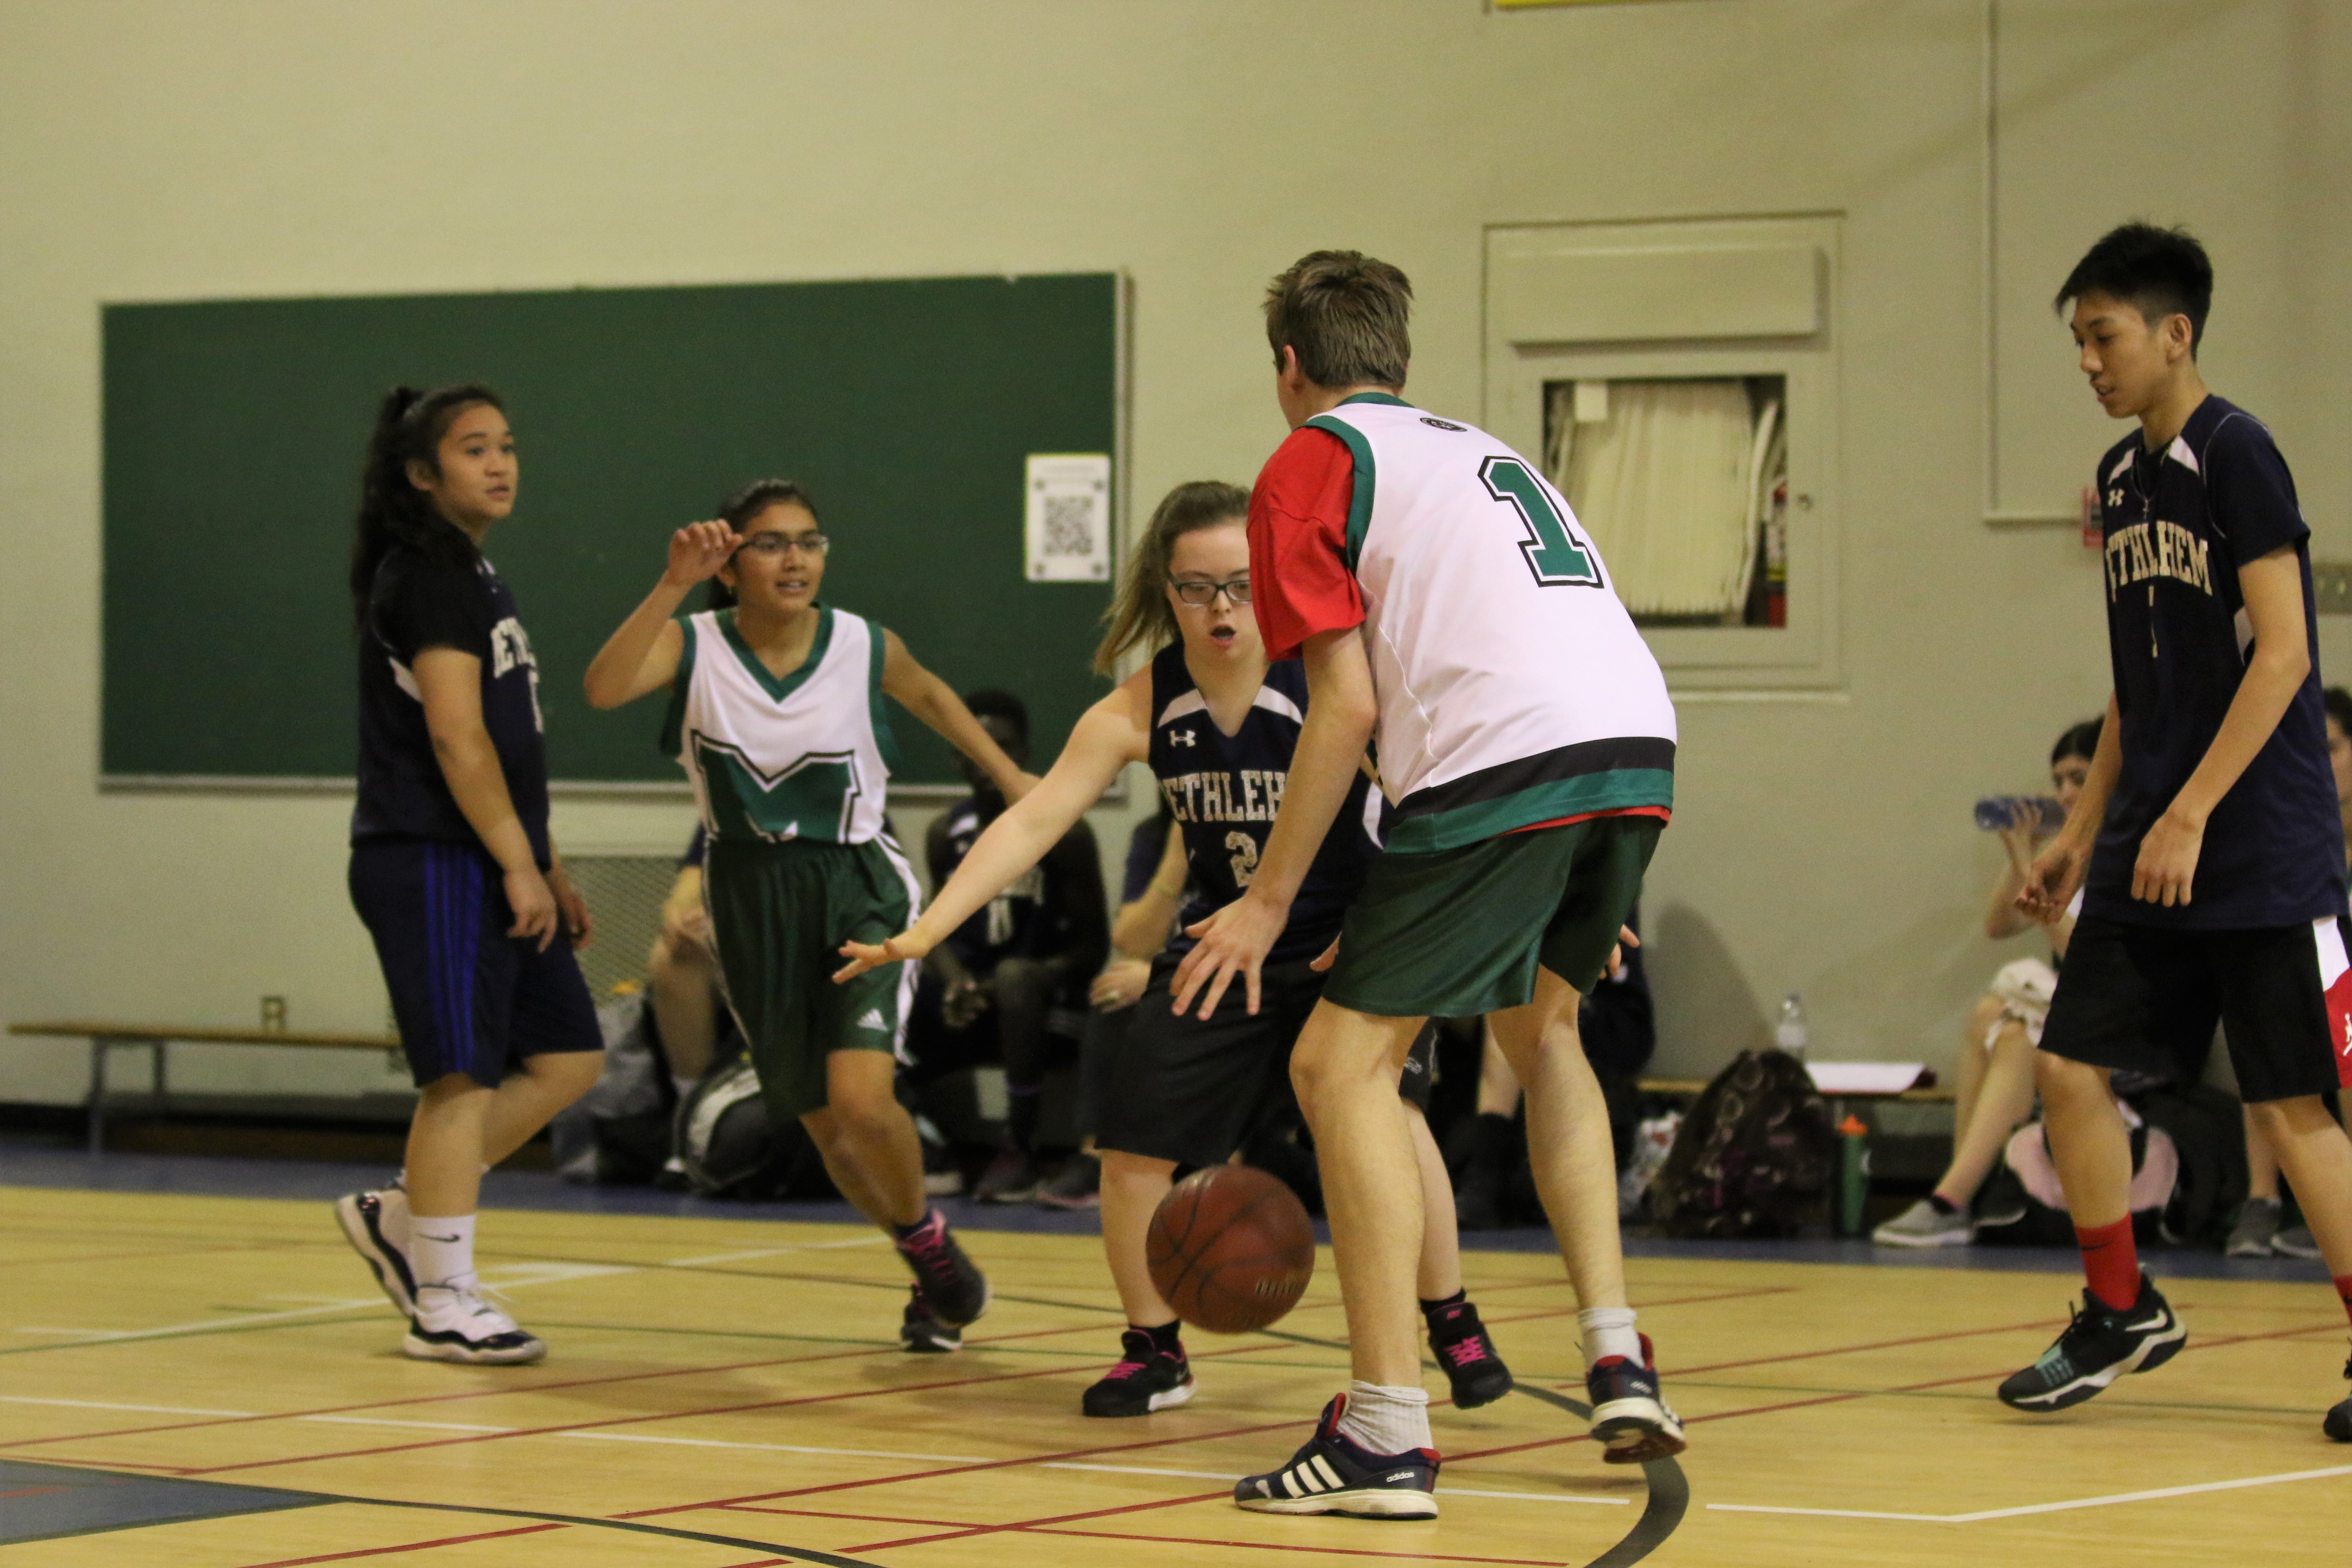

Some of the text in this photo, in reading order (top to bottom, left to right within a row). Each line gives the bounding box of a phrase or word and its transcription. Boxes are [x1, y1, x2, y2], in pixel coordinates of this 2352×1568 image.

[1477, 456, 1605, 589] 1
[1225, 831, 1258, 888] 2
[1386, 1472, 1415, 1482] adidas
